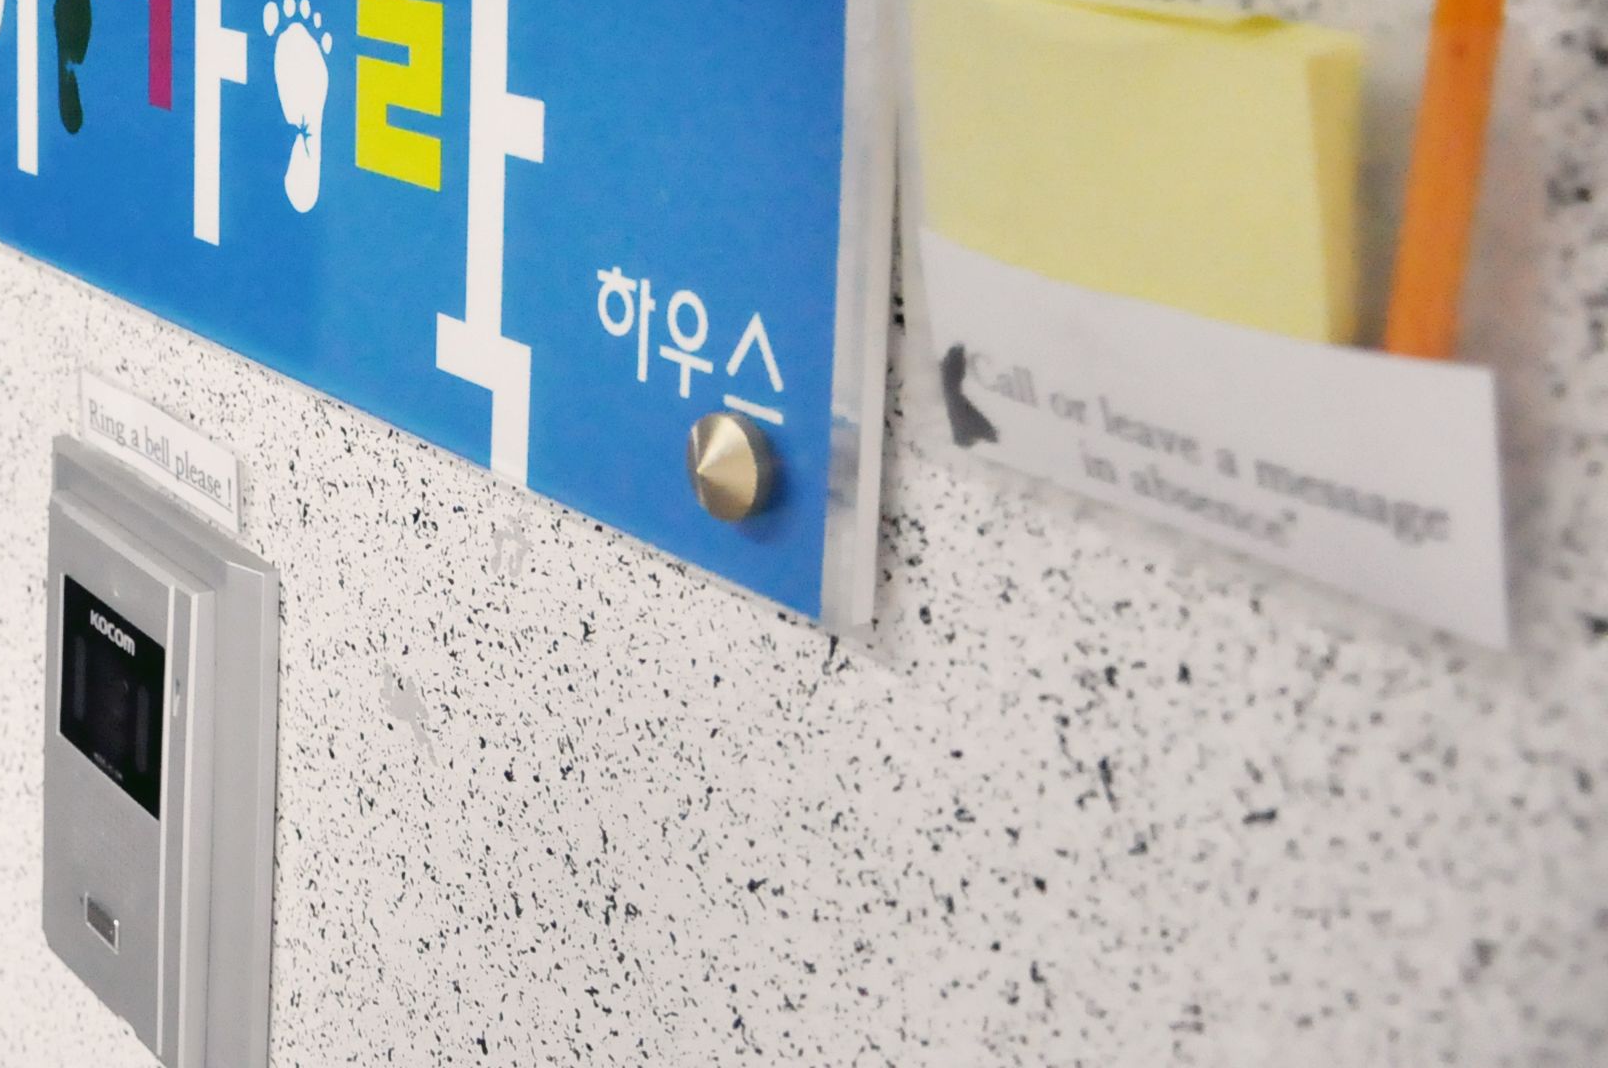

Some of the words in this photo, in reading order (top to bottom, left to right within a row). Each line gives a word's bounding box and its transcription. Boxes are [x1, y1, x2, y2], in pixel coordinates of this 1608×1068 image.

[597, 266, 784, 425] 하우스
[88, 398, 127, 447] Ring
[130, 428, 140, 448] a
[144, 425, 170, 468] bell
